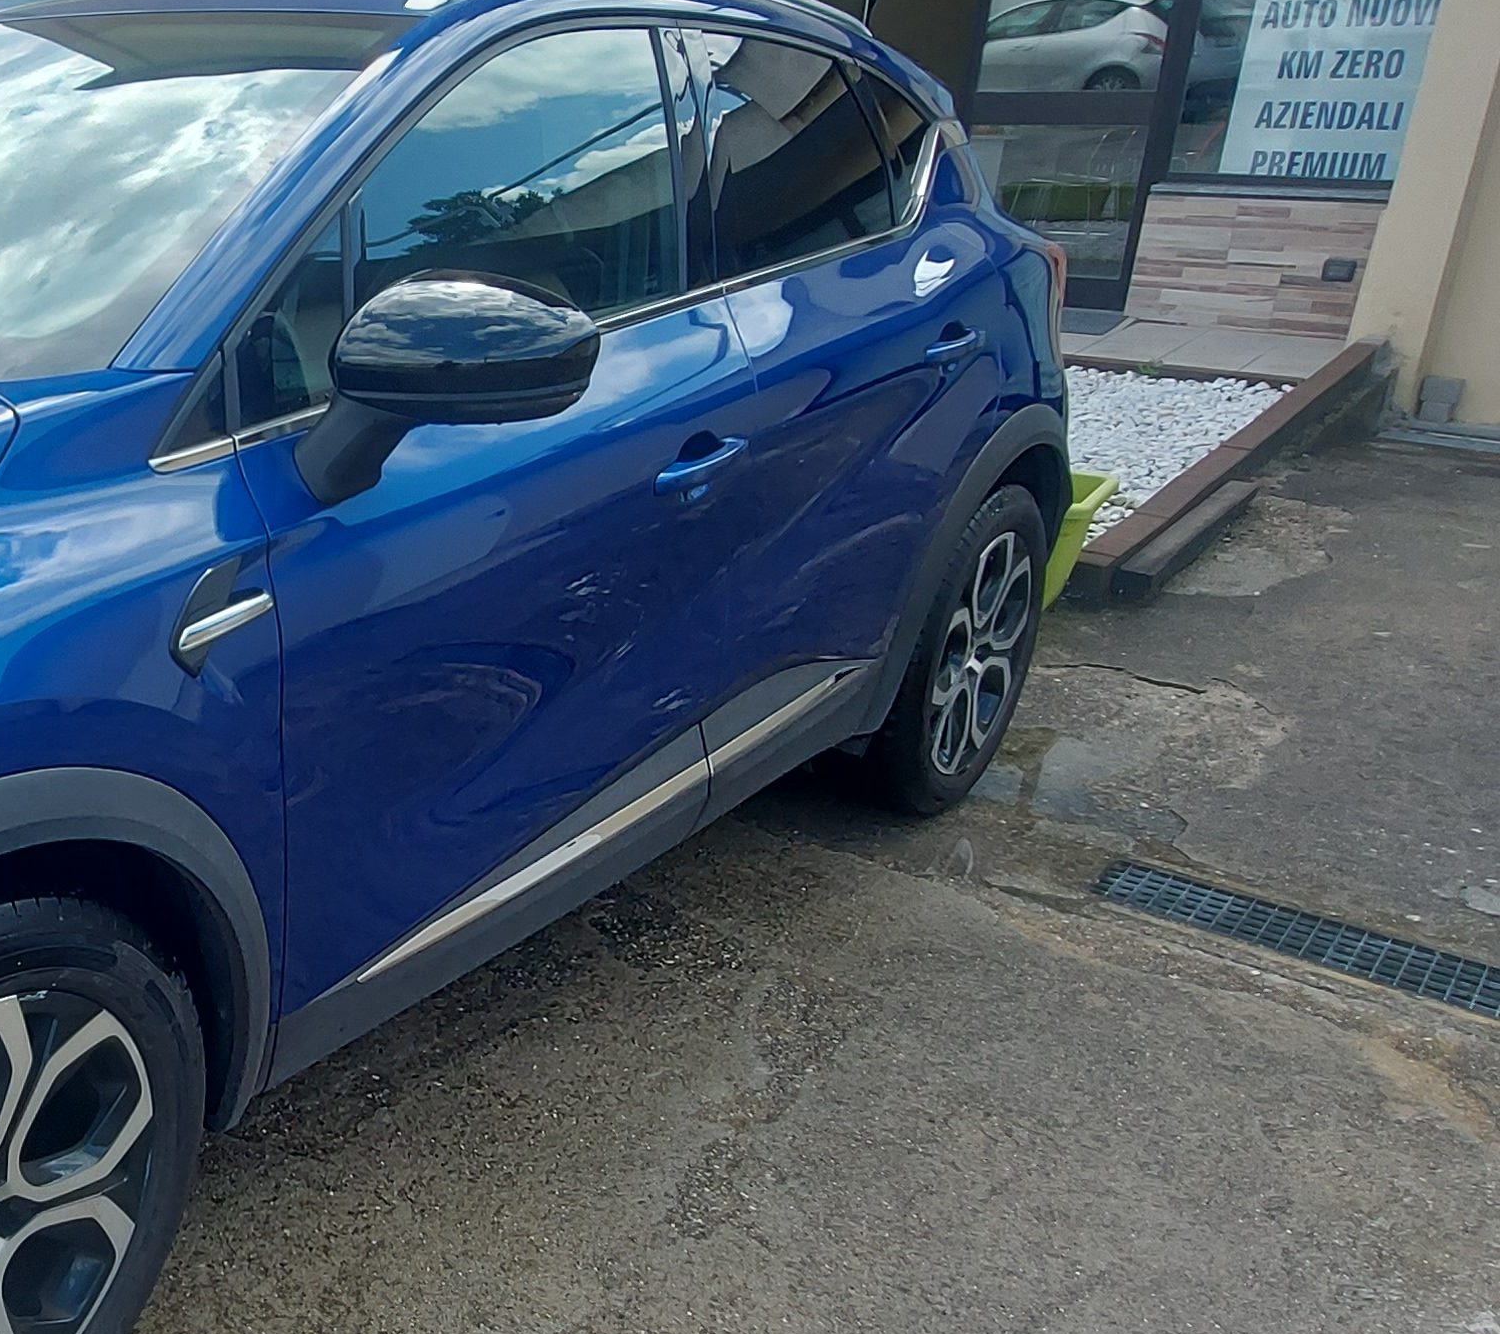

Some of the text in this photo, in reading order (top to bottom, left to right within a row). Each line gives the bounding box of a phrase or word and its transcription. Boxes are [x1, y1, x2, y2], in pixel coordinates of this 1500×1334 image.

[1261, 0, 1338, 29] AUTO
[1277, 49, 1405, 79] KM ZERO
[1254, 101, 1404, 130] AZIENDALI
[1250, 150, 1387, 179] PREMIUM
